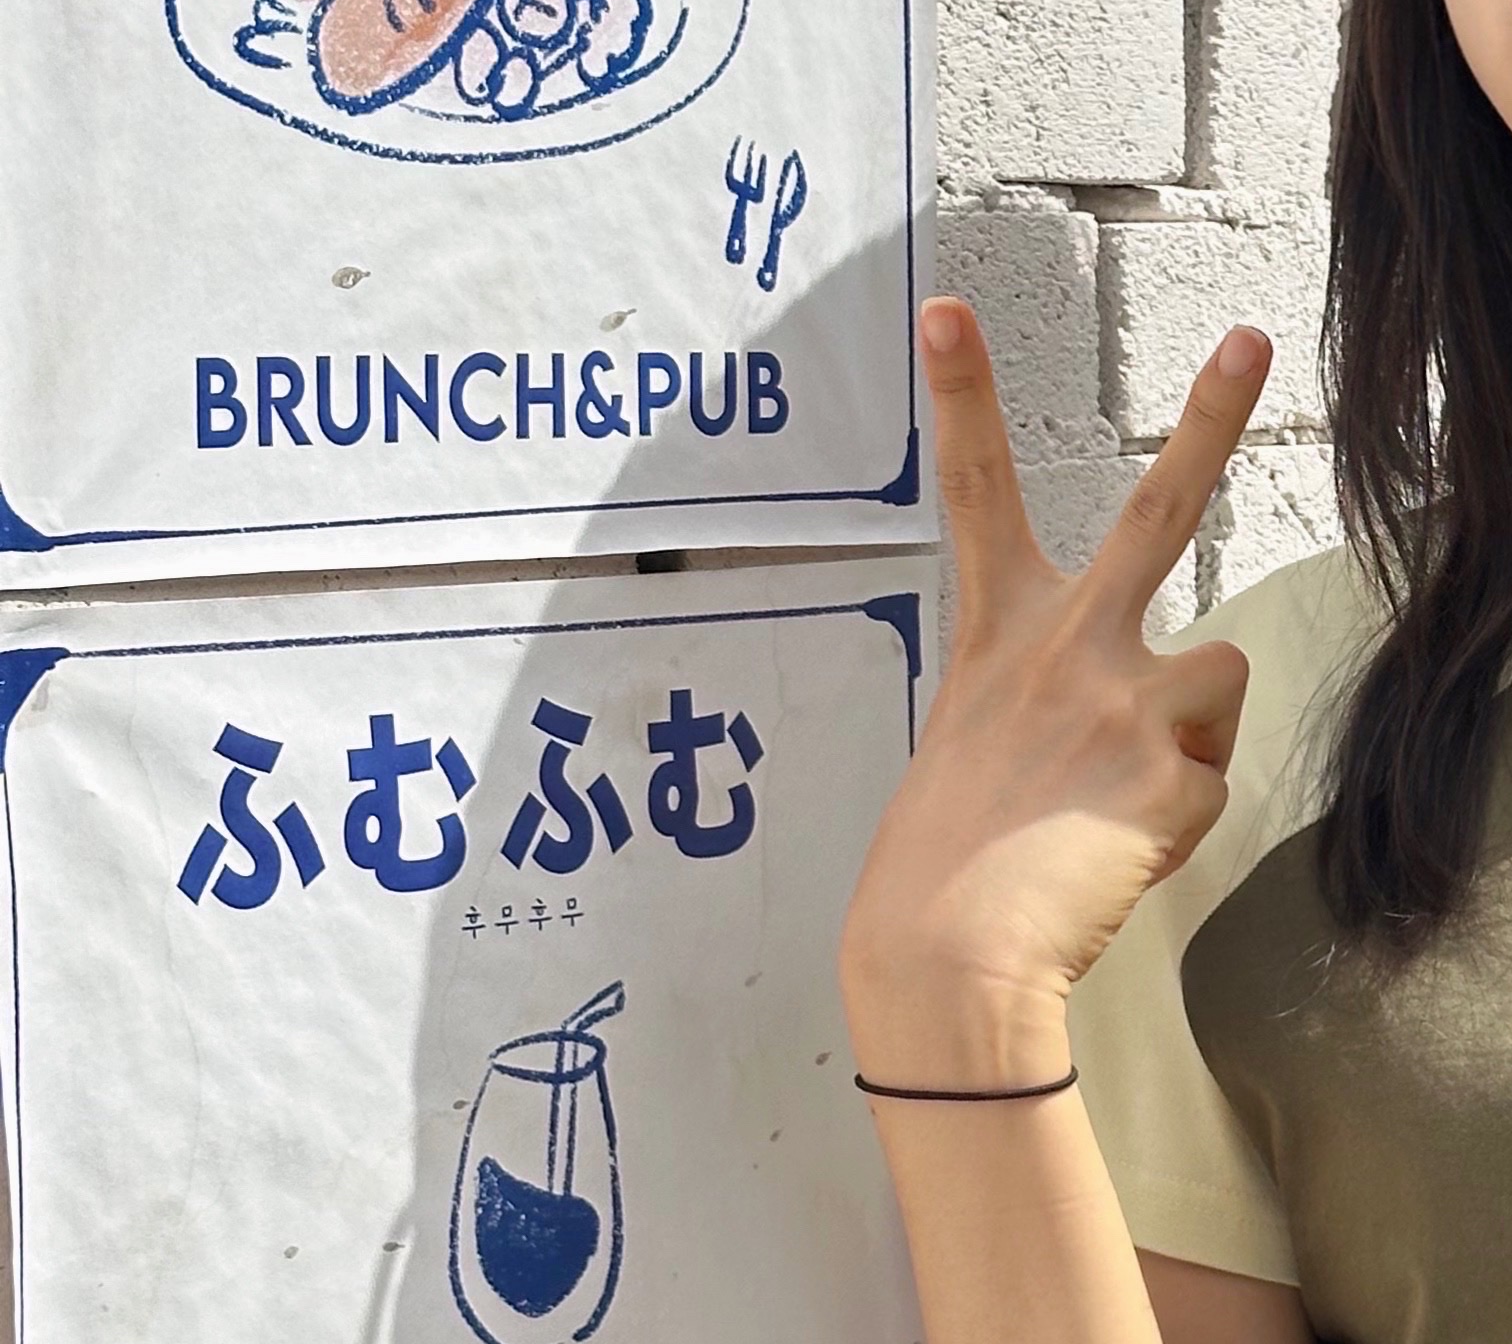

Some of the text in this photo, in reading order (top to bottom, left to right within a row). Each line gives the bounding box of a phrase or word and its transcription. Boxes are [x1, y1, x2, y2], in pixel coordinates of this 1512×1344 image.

[195, 350, 789, 449] BRUNCH&PUB
[178, 689, 764, 910] ふむふむ
[461, 897, 585, 940] 후무후무
